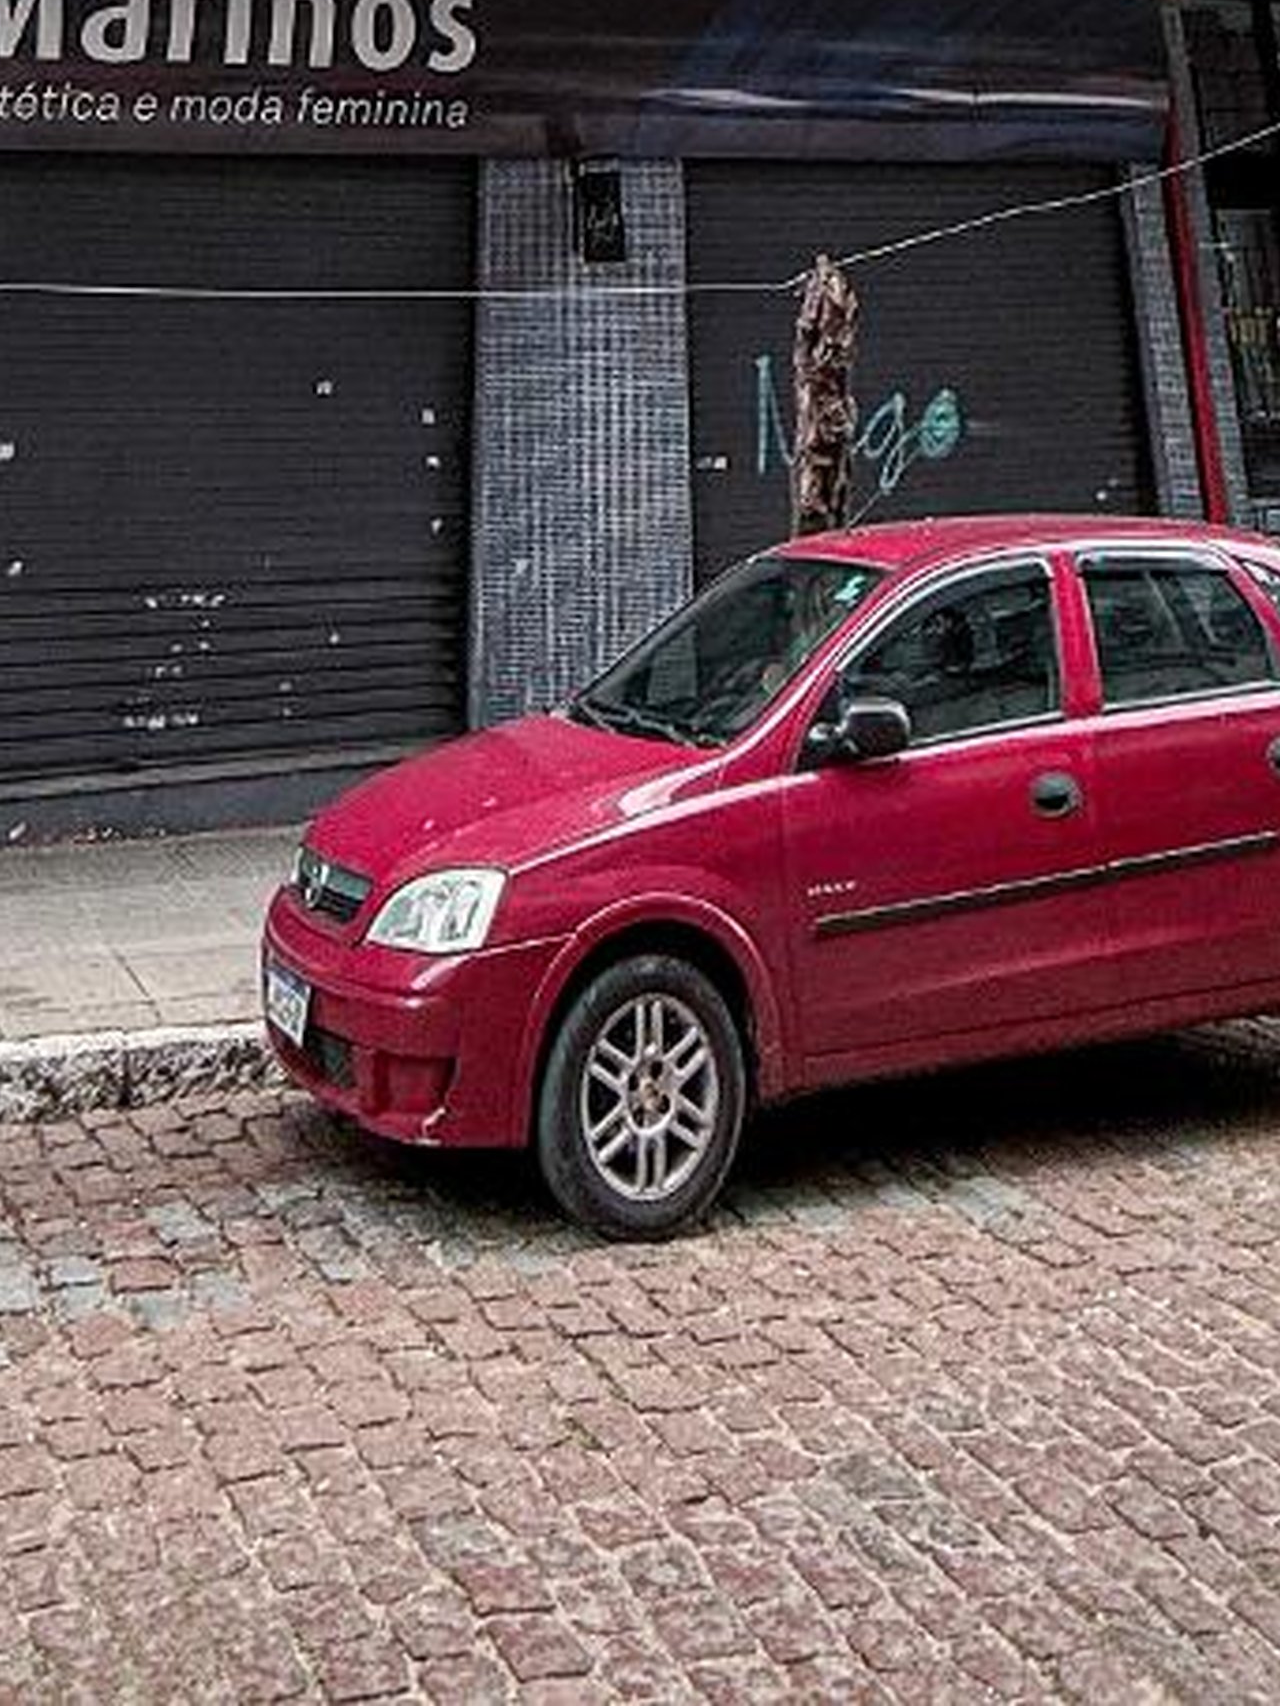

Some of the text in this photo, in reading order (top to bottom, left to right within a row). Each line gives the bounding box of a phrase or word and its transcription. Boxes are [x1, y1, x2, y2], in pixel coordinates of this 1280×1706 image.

[132, 93, 158, 121] e
[169, 89, 286, 126] moda
[297, 87, 469, 129] feminina
